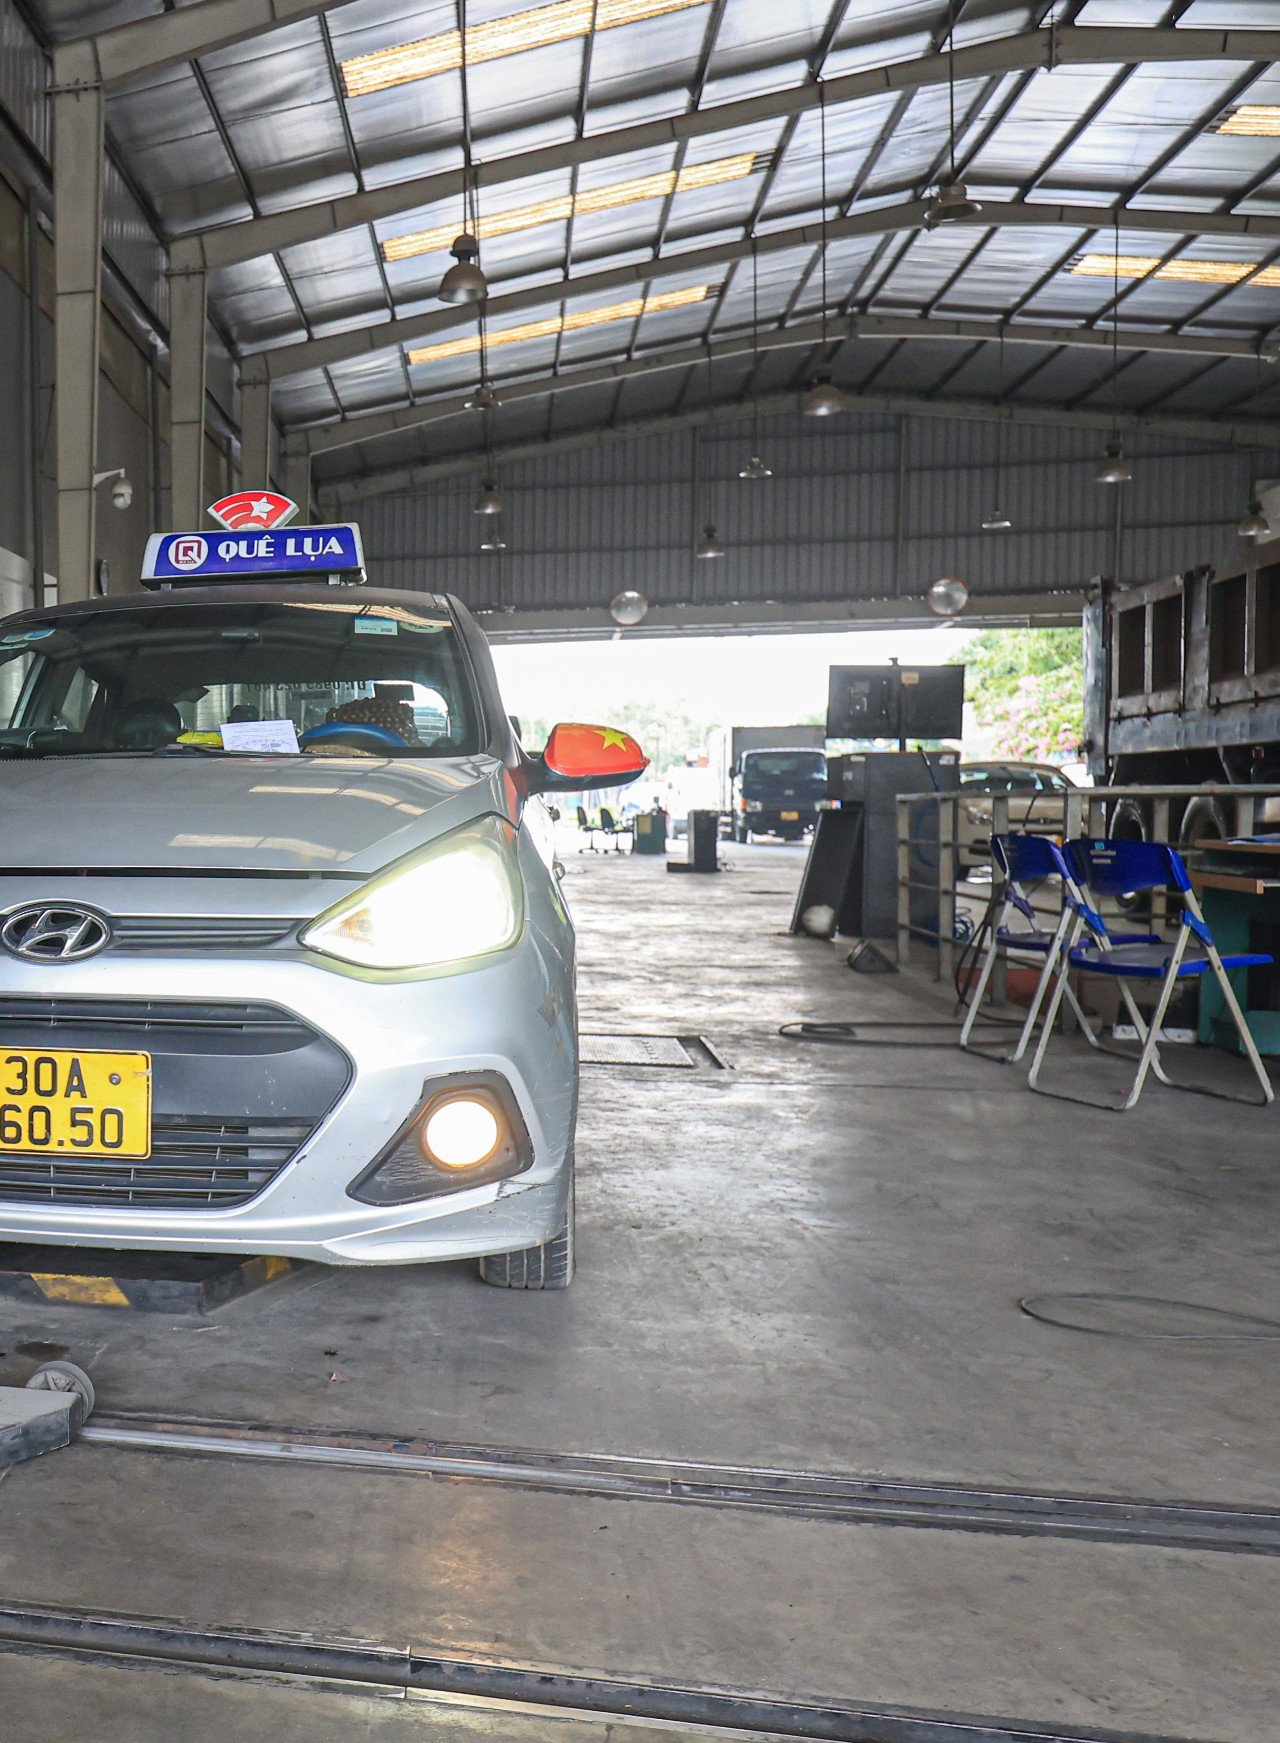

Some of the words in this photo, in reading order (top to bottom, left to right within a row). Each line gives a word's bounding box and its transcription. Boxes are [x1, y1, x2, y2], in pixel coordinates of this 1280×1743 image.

[218, 535, 274, 562] QUÊ
[286, 537, 344, 561] LỤA
[5, 1056, 87, 1098] 30A
